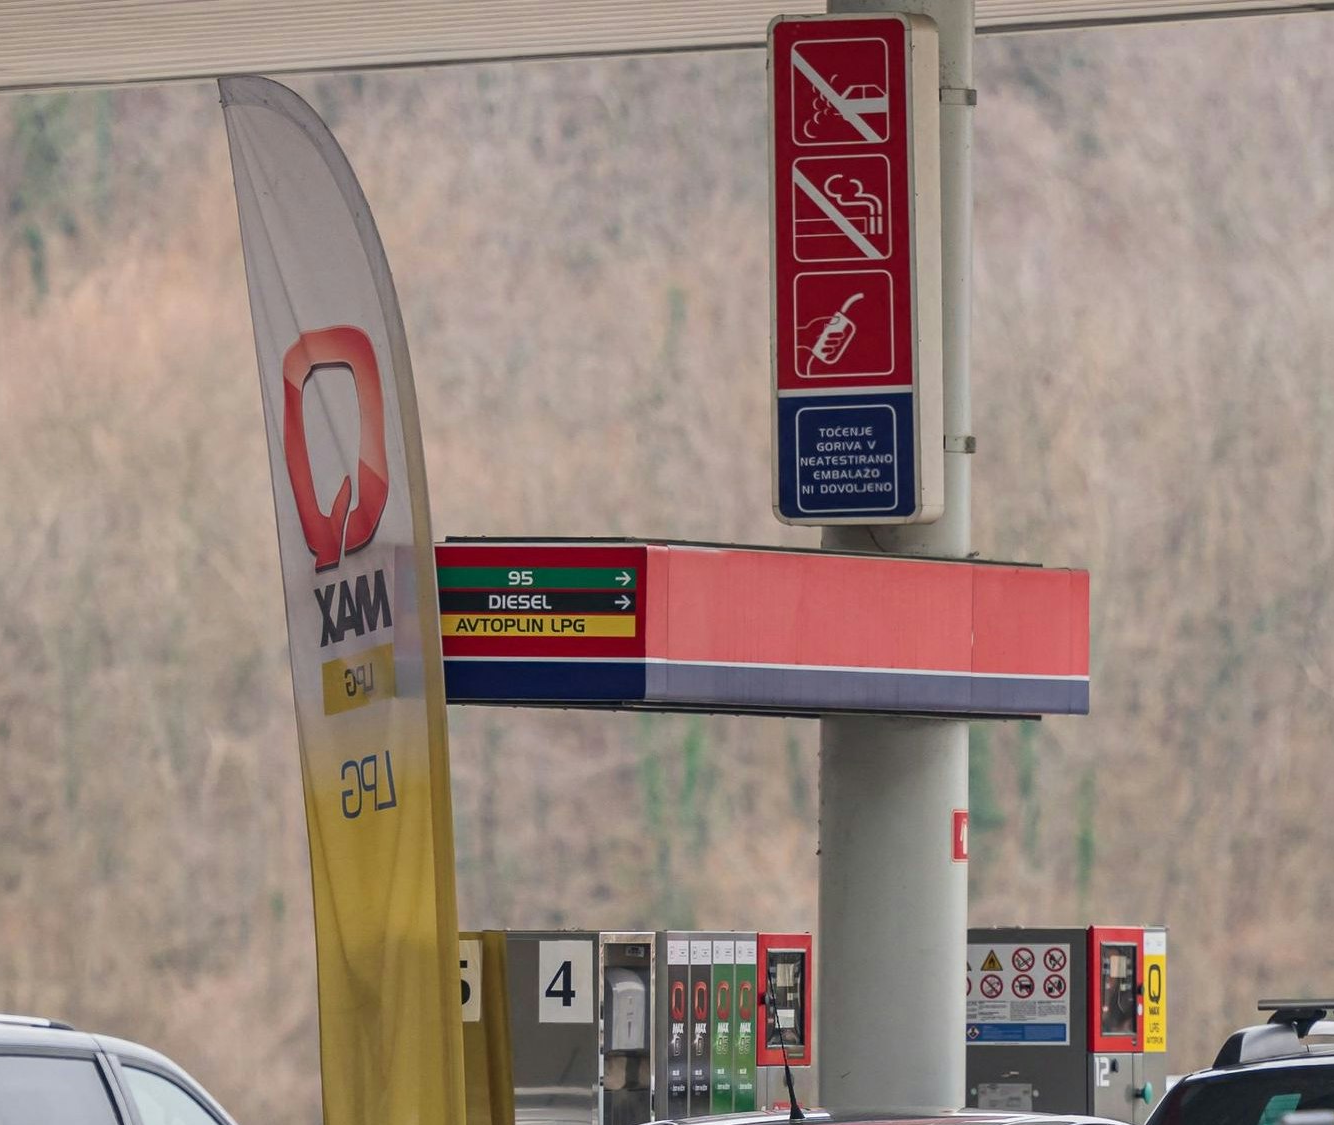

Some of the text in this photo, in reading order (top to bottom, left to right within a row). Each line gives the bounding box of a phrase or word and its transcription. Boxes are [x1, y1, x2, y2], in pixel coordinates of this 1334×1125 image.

[819, 425, 873, 438] TOČENJE
[816, 440, 877, 452] GORIVA V
[800, 454, 894, 467] NEATESTIRANO
[813, 467, 880, 480] EMBALAŽO
[801, 482, 893, 495] NI DOVOLJENO
[508, 571, 534, 586] 95
[488, 594, 552, 610] DIESEL
[456, 618, 586, 633] AVTOPLIN LPG
[545, 960, 576, 1007] 4
